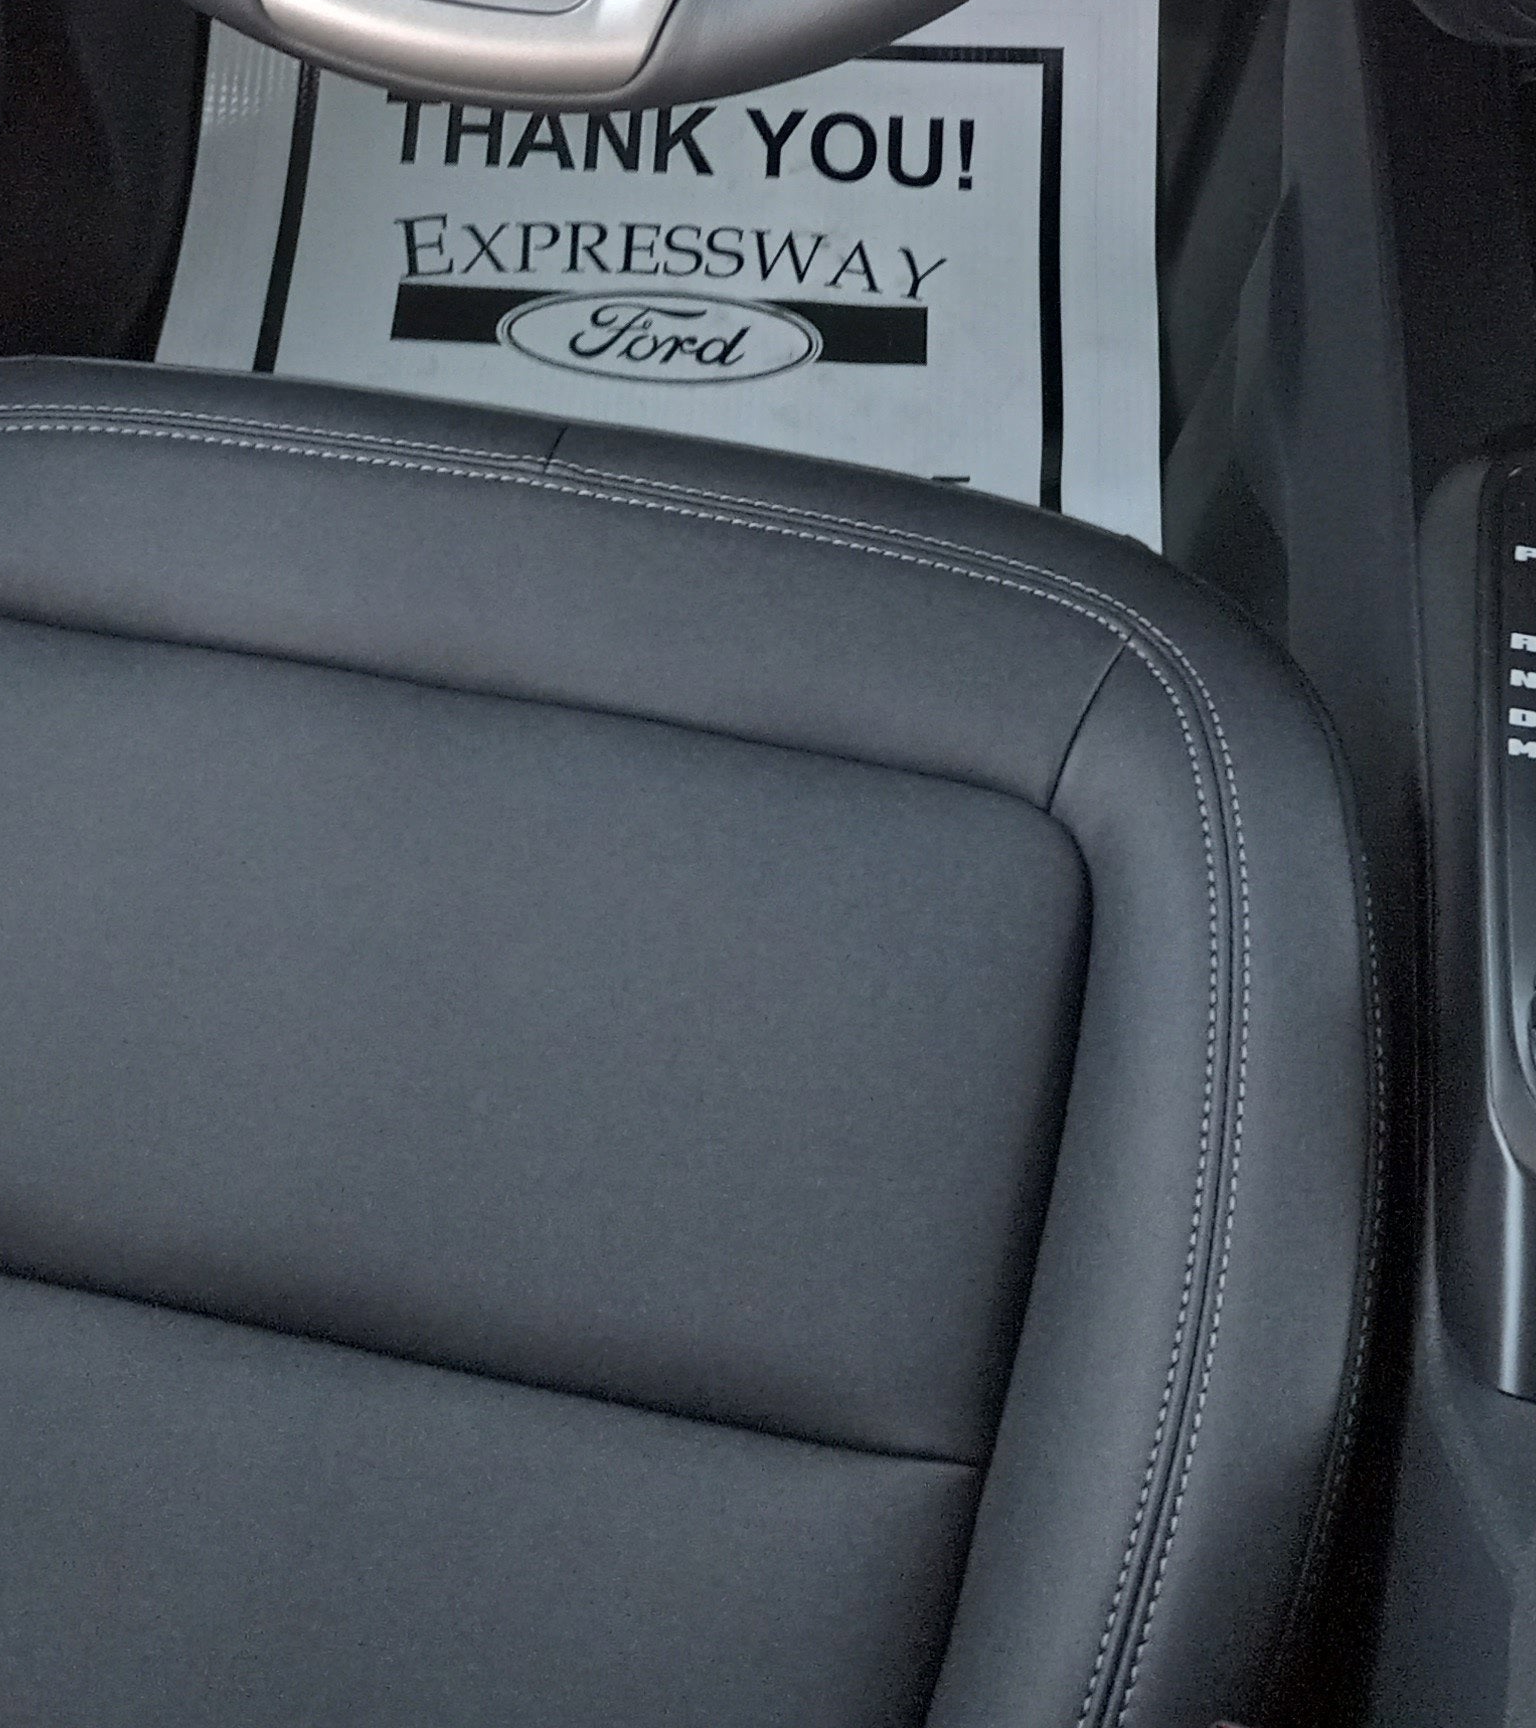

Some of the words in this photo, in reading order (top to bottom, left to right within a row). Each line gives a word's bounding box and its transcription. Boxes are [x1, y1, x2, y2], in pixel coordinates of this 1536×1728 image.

[386, 88, 719, 176] THANK
[746, 107, 976, 191] YOU!
[393, 212, 948, 301] EXPRESSWAY
[568, 301, 752, 368] Ford
